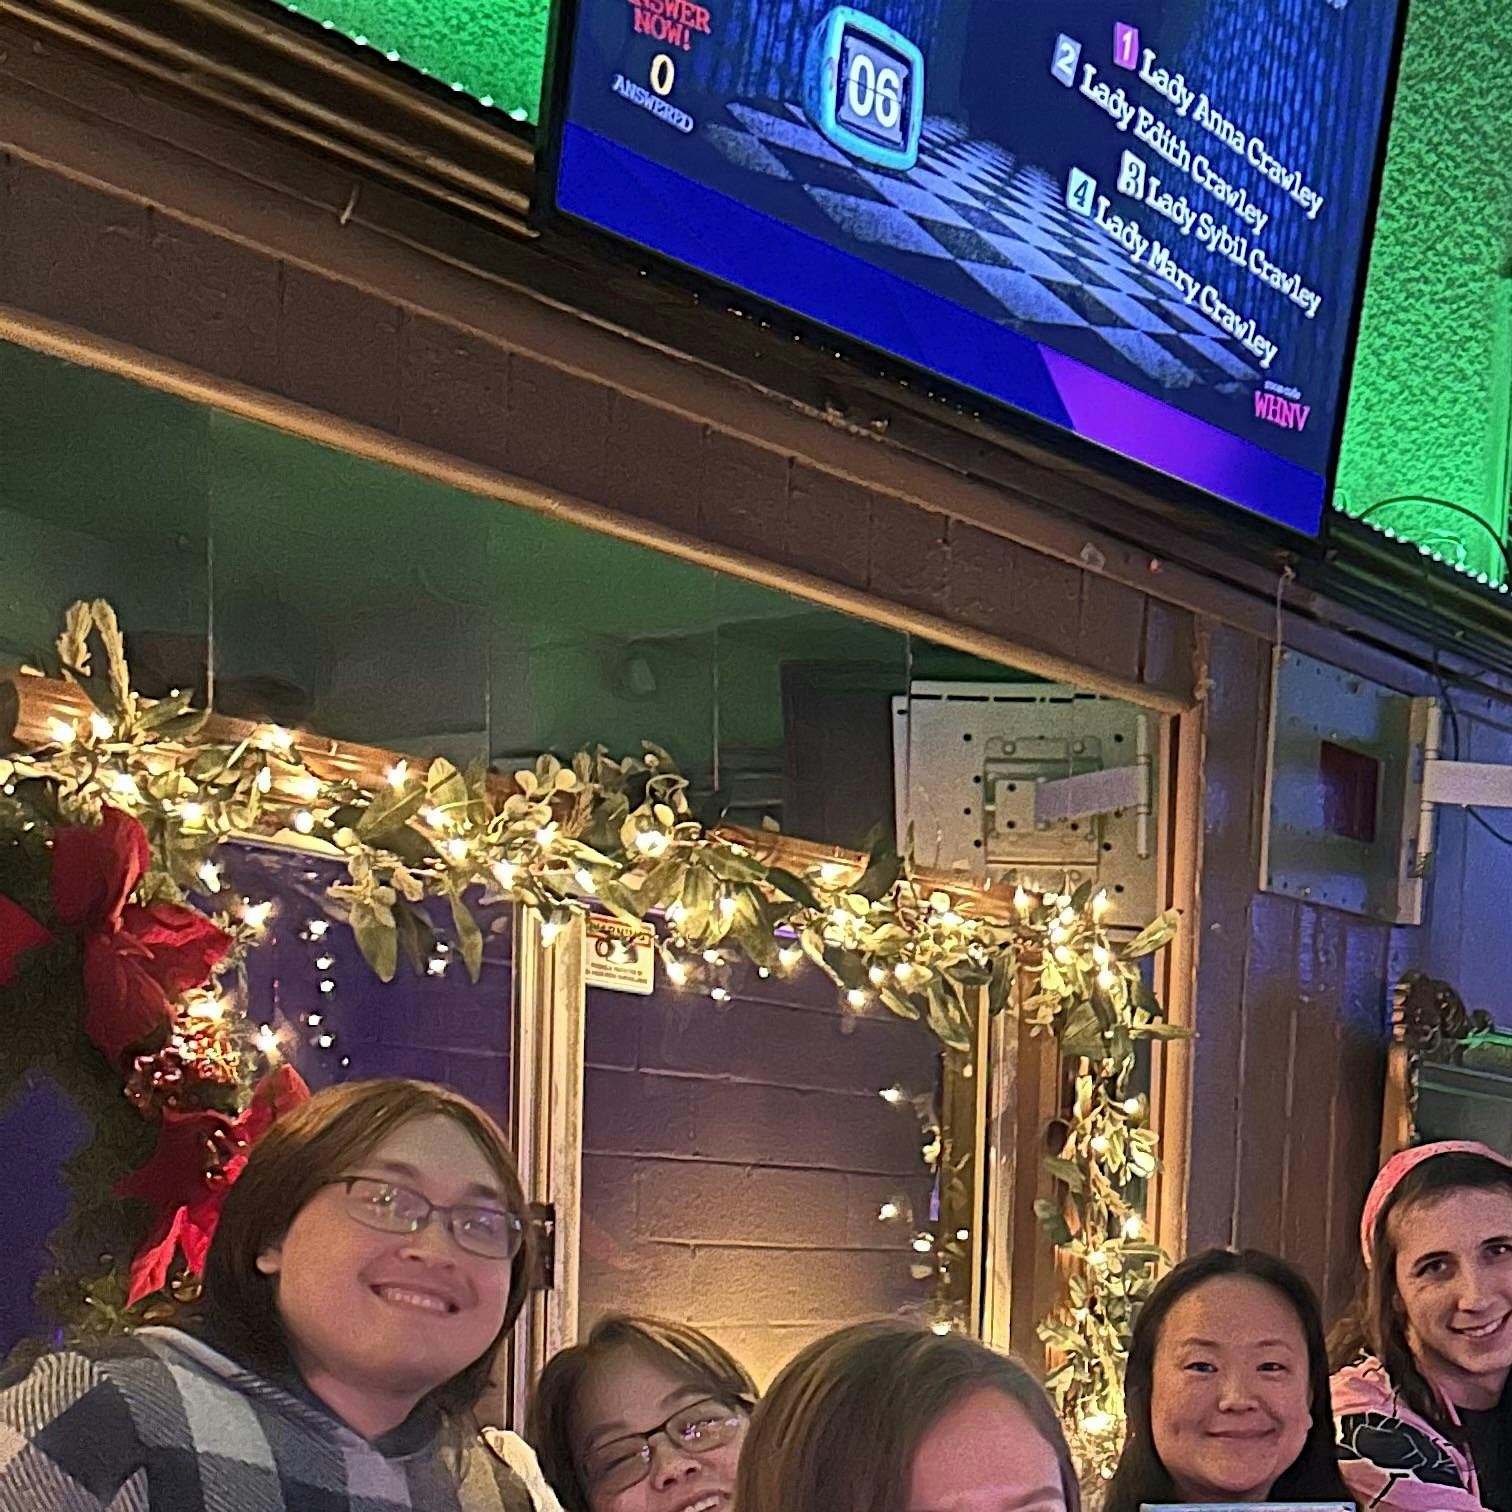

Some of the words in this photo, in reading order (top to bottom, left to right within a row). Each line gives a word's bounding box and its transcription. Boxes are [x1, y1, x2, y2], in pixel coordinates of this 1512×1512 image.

[632, 8, 691, 51] NOW!
[612, 74, 694, 133] ANSWERED
[650, 54, 674, 96] 0
[849, 54, 900, 128] 06
[1079, 63, 1135, 131] Lady
[1134, 107, 1190, 172] Edith
[1192, 155, 1268, 236] Crawley
[1139, 48, 1195, 116] Lady
[1193, 94, 1244, 155] Anna
[1249, 137, 1323, 219] Crawley
[1094, 196, 1149, 263] Lady
[1149, 241, 1201, 304] Mary
[1201, 286, 1278, 369] Crawley
[1145, 176, 1197, 235] Lady
[1196, 215, 1247, 266] Sybil
[1250, 249, 1322, 319] Crawley
[1255, 390, 1311, 431] WHNV
